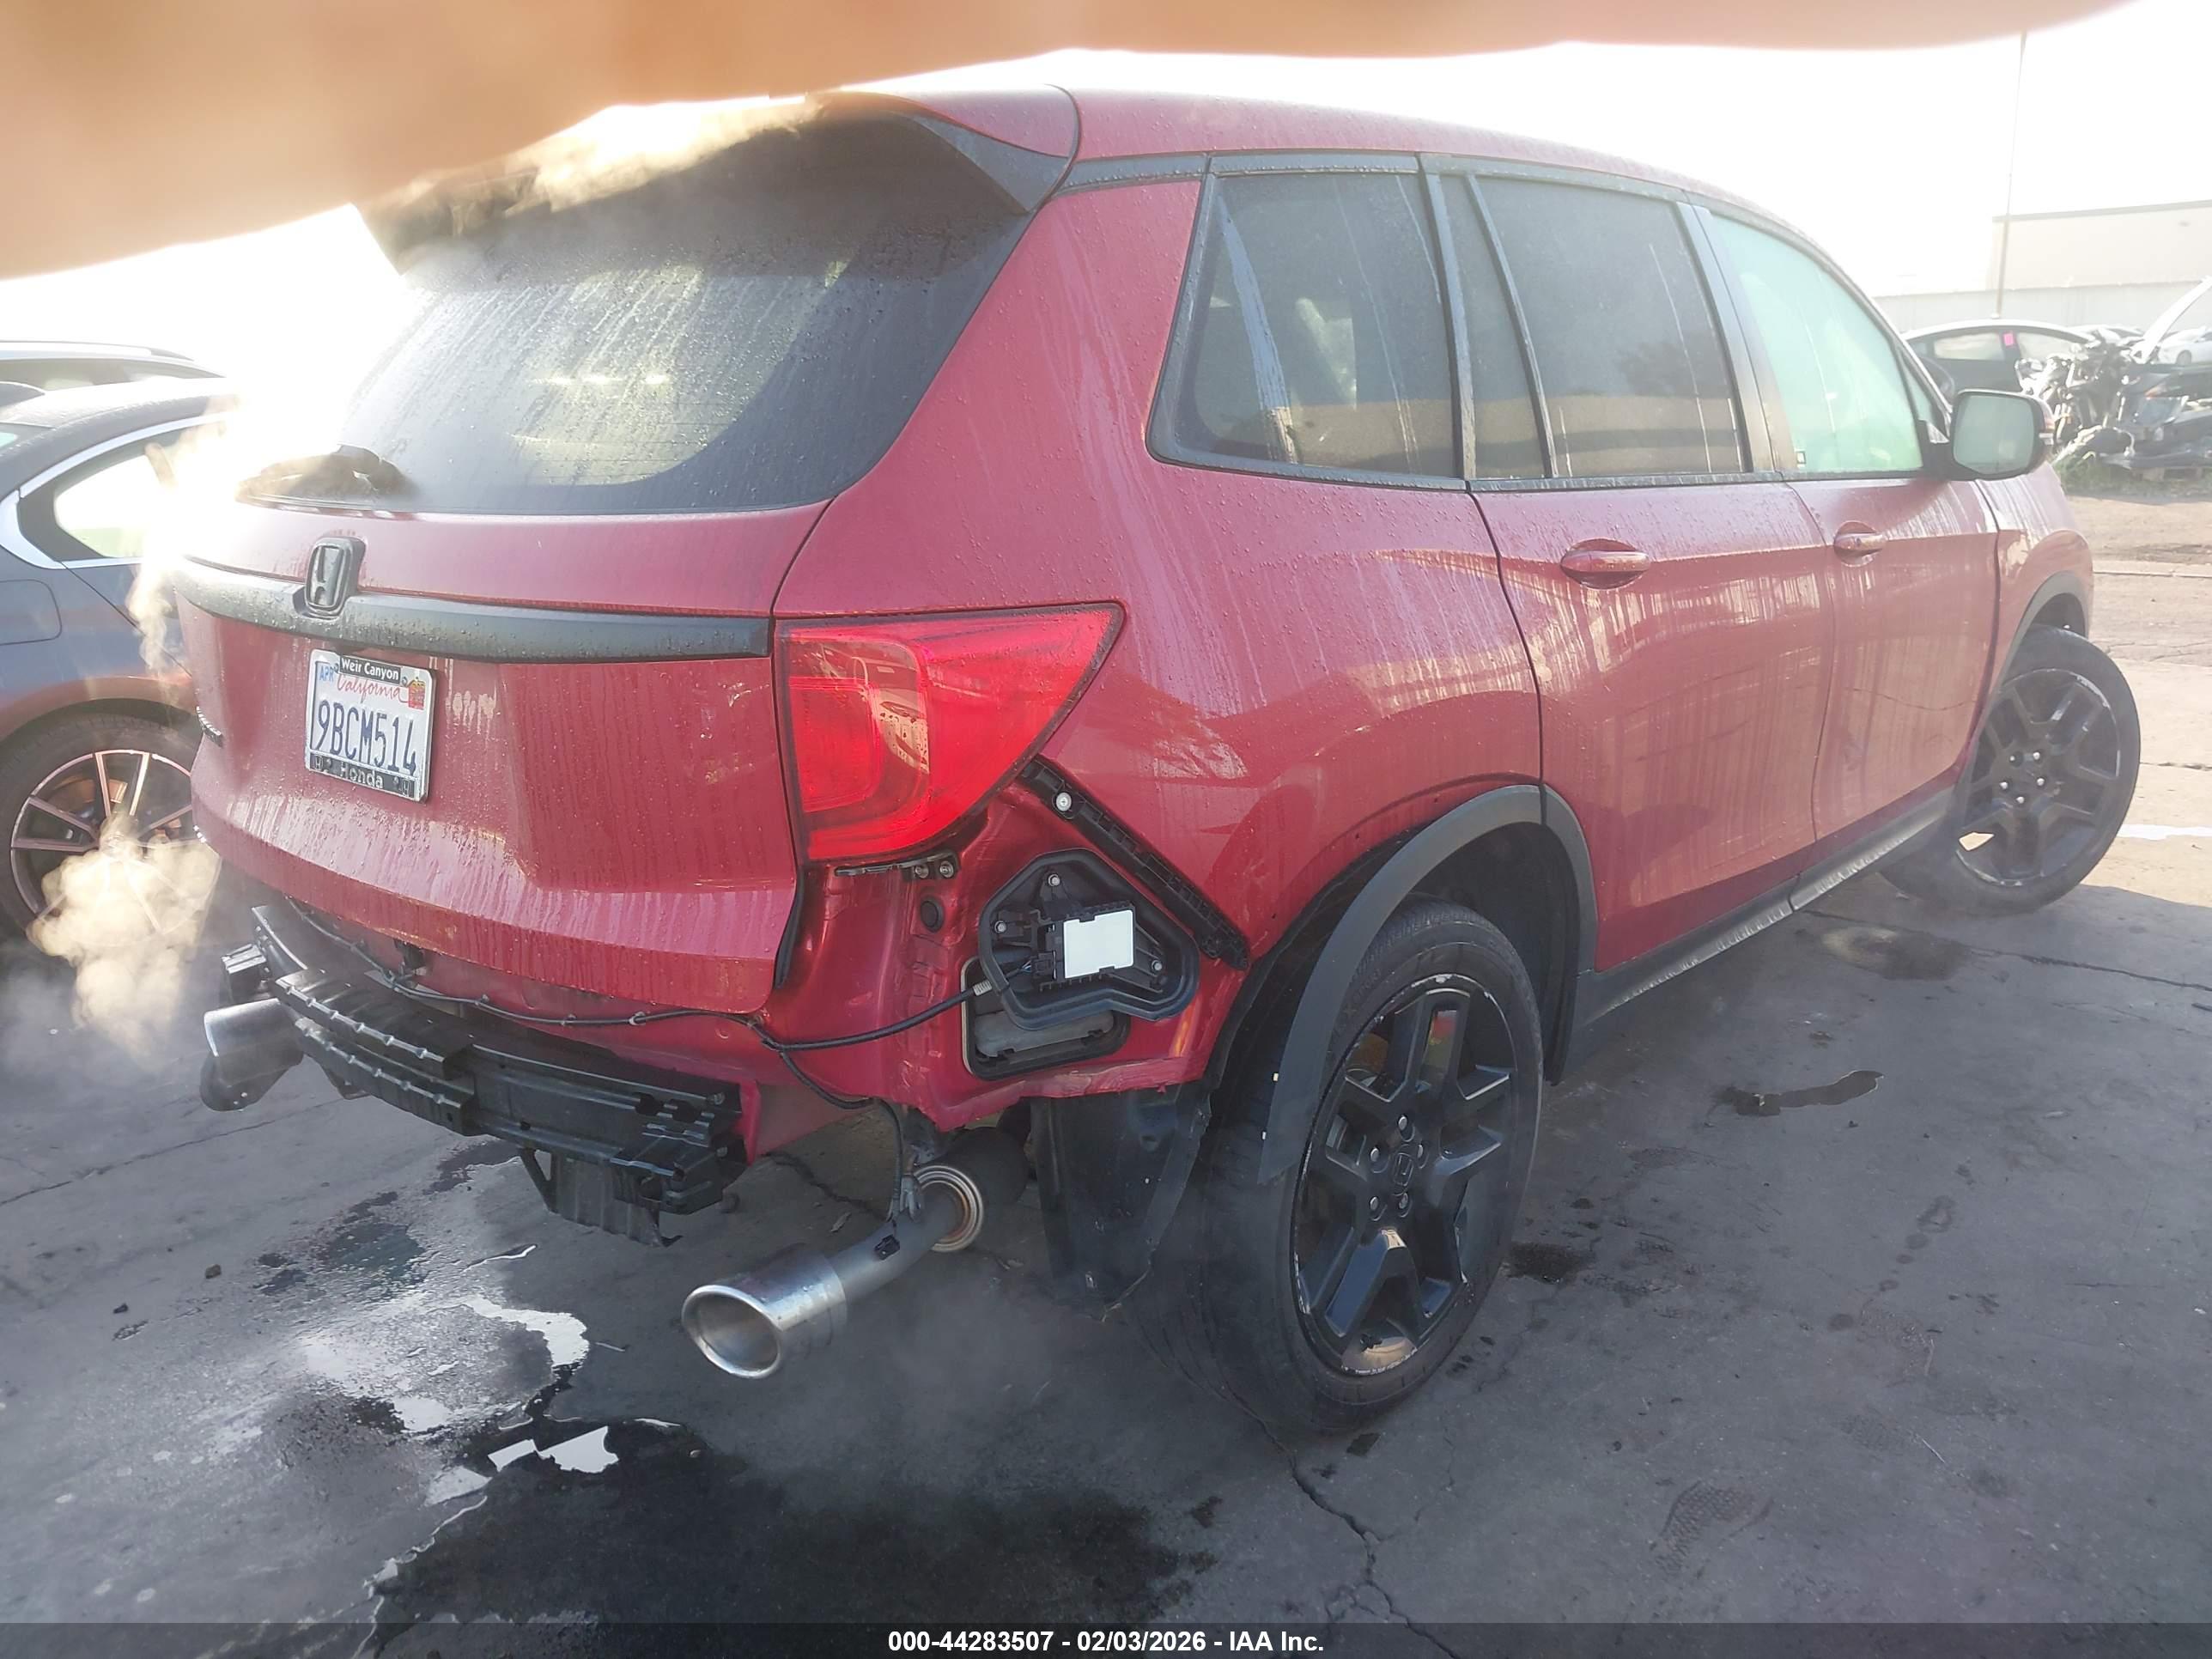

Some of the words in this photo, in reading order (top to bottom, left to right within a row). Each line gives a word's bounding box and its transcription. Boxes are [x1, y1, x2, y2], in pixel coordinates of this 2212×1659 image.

[319, 665, 334, 682] APR
[341, 657, 362, 674] Weir
[364, 662, 399, 680] Canyon
[317, 699, 417, 776] 9BCM514
[340, 762, 384, 788] Honda
